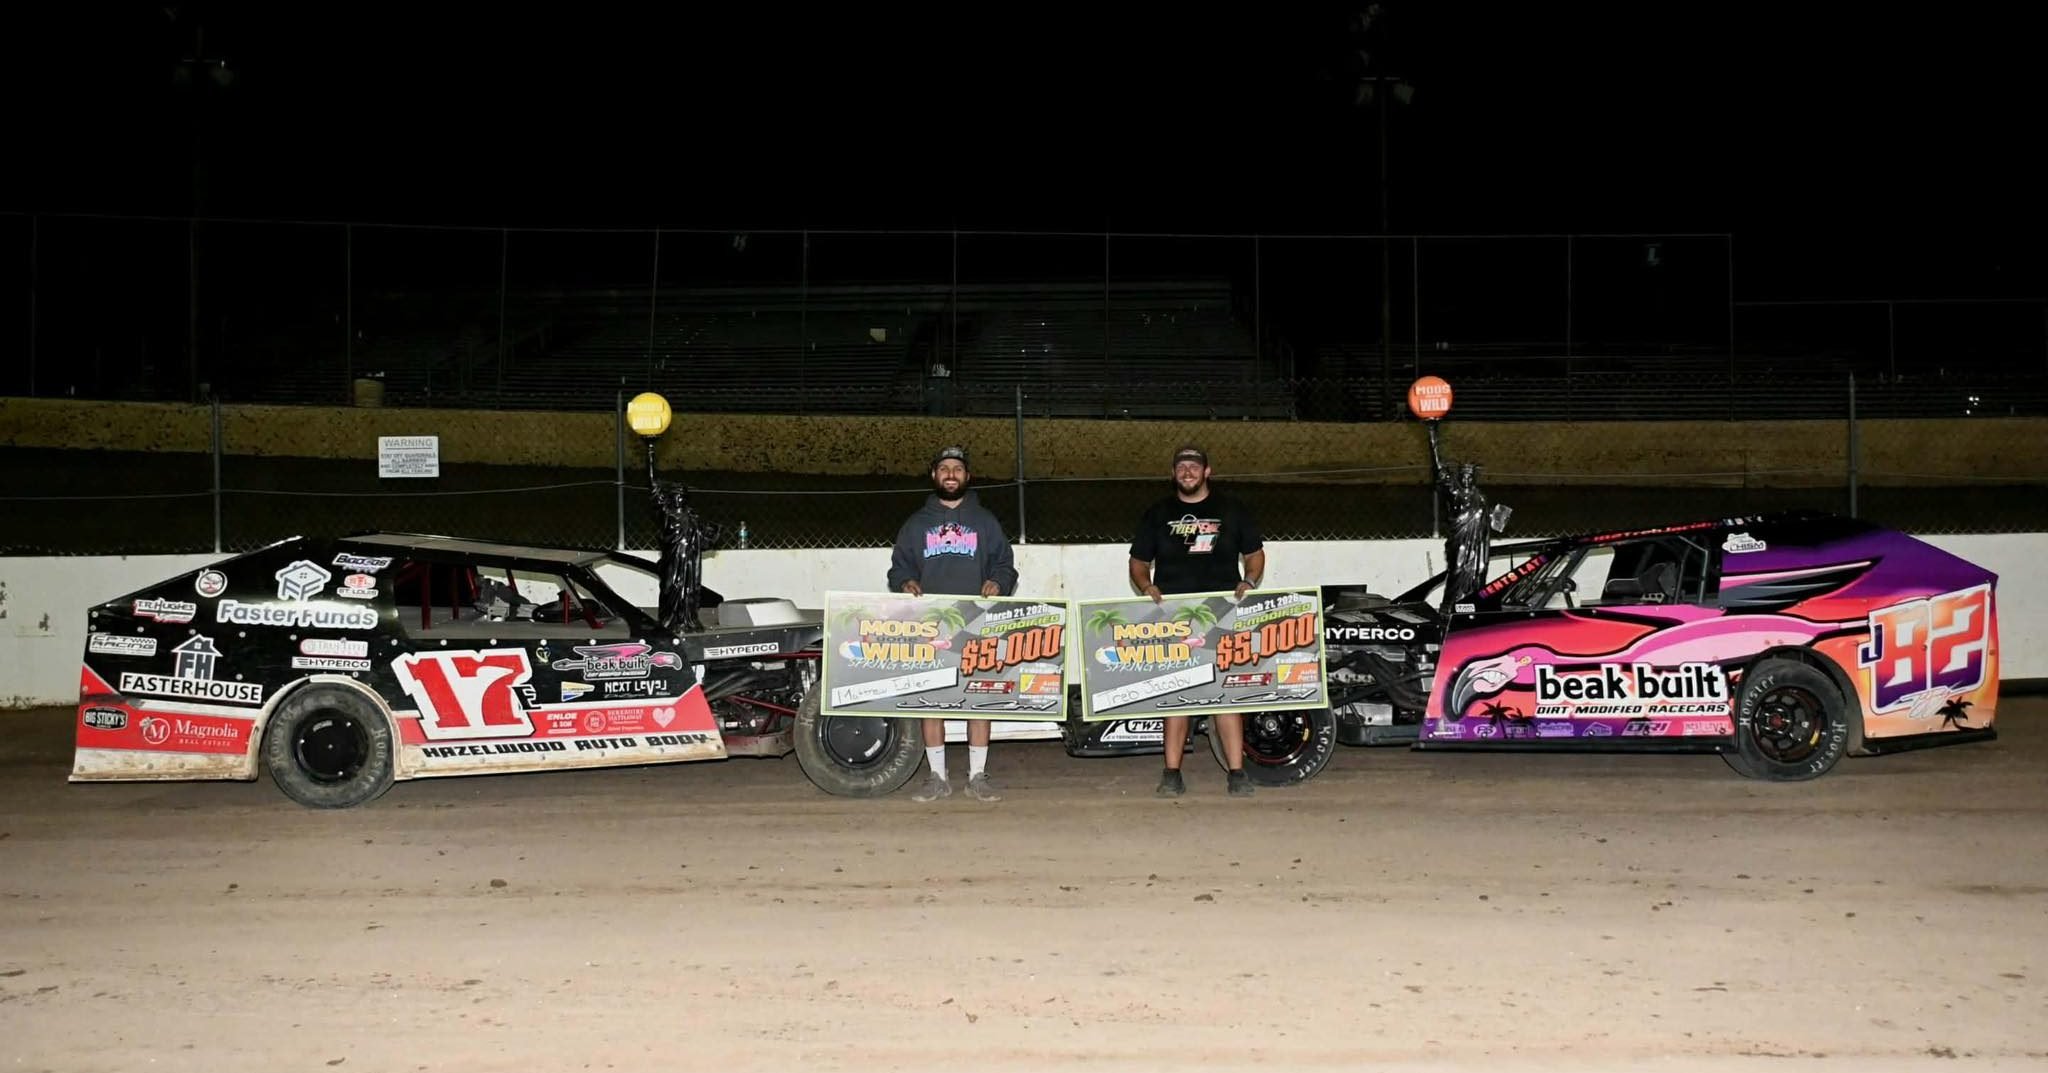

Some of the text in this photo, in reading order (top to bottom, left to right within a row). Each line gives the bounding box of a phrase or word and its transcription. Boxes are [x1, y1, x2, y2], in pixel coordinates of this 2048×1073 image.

[1415, 384, 1450, 395] MODS
[1420, 398, 1448, 411] WILD
[384, 438, 433, 447] WARNING
[220, 603, 375, 626] Faster Funds
[985, 610, 1013, 622] March
[1236, 602, 1263, 617] March
[860, 619, 940, 637] MODS
[1114, 620, 1192, 640] MODS
[720, 644, 778, 655] HYPERCO
[961, 624, 1063, 676] $5,000
[1216, 612, 1316, 671] $5,000
[861, 642, 936, 663] WILD
[1117, 643, 1190, 663] WILD
[178, 652, 212, 680] FH
[309, 660, 370, 668] HYPERCO
[586, 655, 646, 671] beak built
[848, 658, 945, 671] SPRING BREAK
[1104, 656, 1200, 673] SPRING BREAK
[122, 675, 261, 701] FASTERHOUSE
[1538, 665, 1721, 700] beak built
[85, 711, 96, 723] BIG
[1536, 704, 1726, 715] DIRT MODIFIED RACECARS
[150, 724, 166, 739] M
[174, 719, 238, 738] Magnolia
[422, 733, 709, 758] HAZELWOOD AUTO BODY
